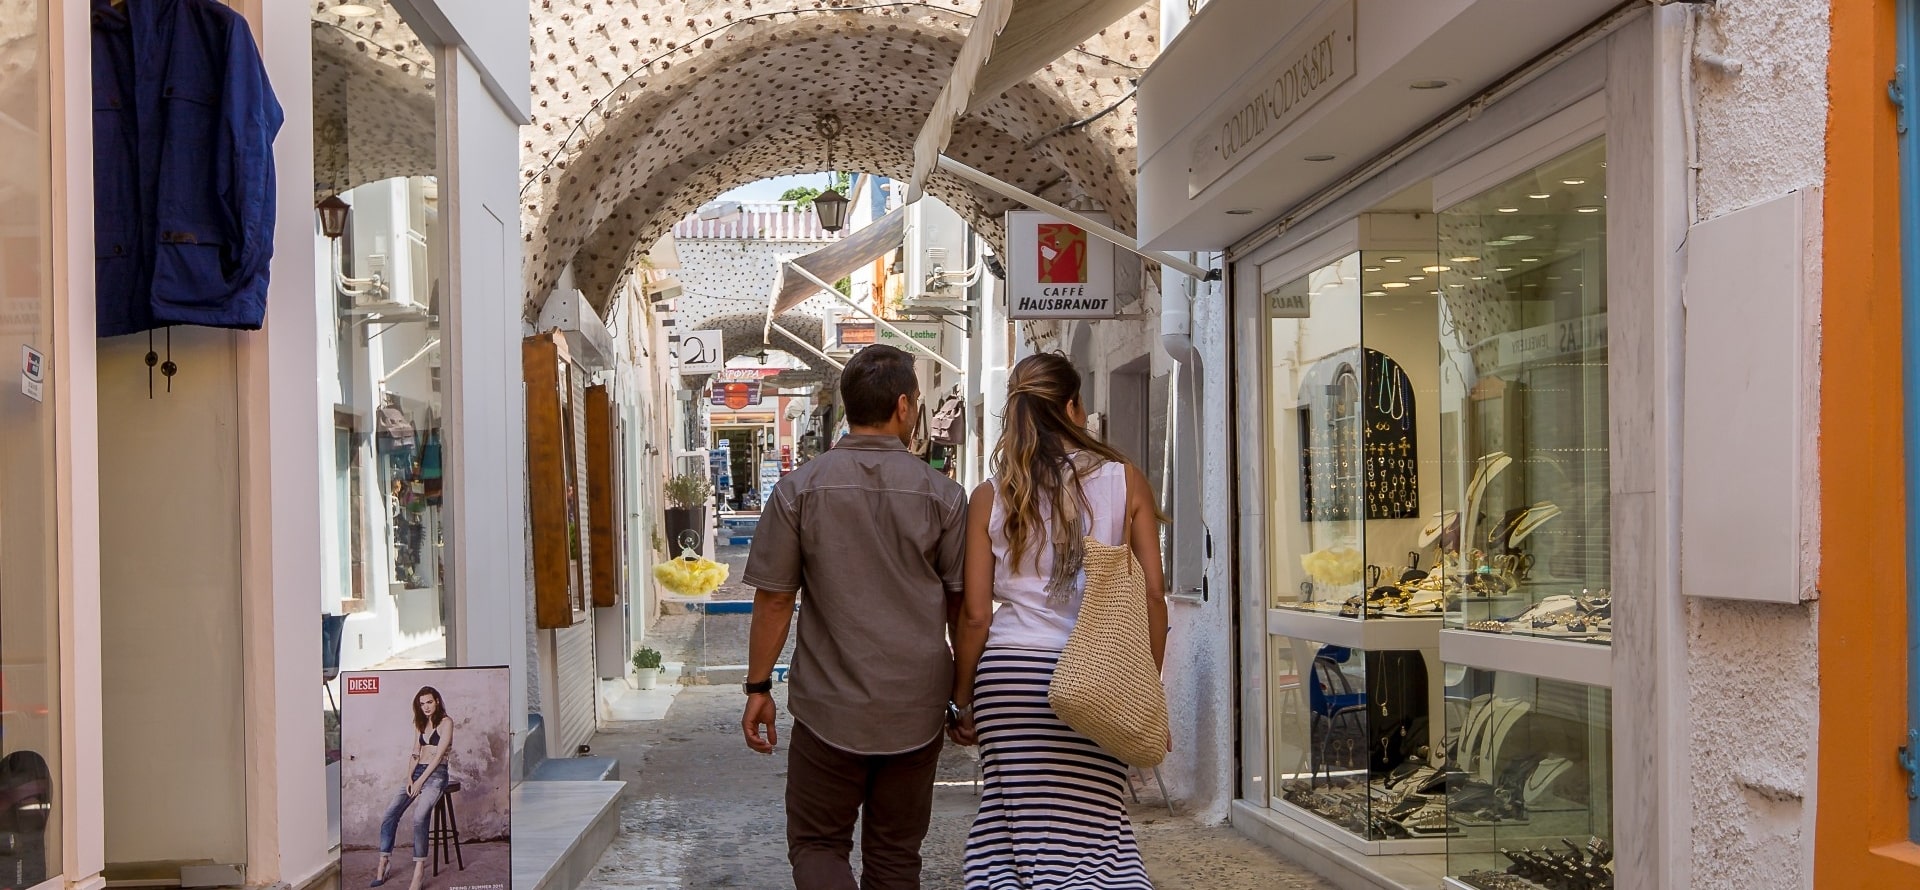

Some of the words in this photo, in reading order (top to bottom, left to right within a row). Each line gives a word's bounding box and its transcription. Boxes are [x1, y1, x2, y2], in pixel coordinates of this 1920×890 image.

[1221, 89, 1269, 161] GOLDEN
[1272, 29, 1336, 120] ODYSSEY
[1018, 297, 1109, 311] HAUSBRANDT
[910, 329, 937, 339] Leather
[350, 679, 378, 691] DIESEL
